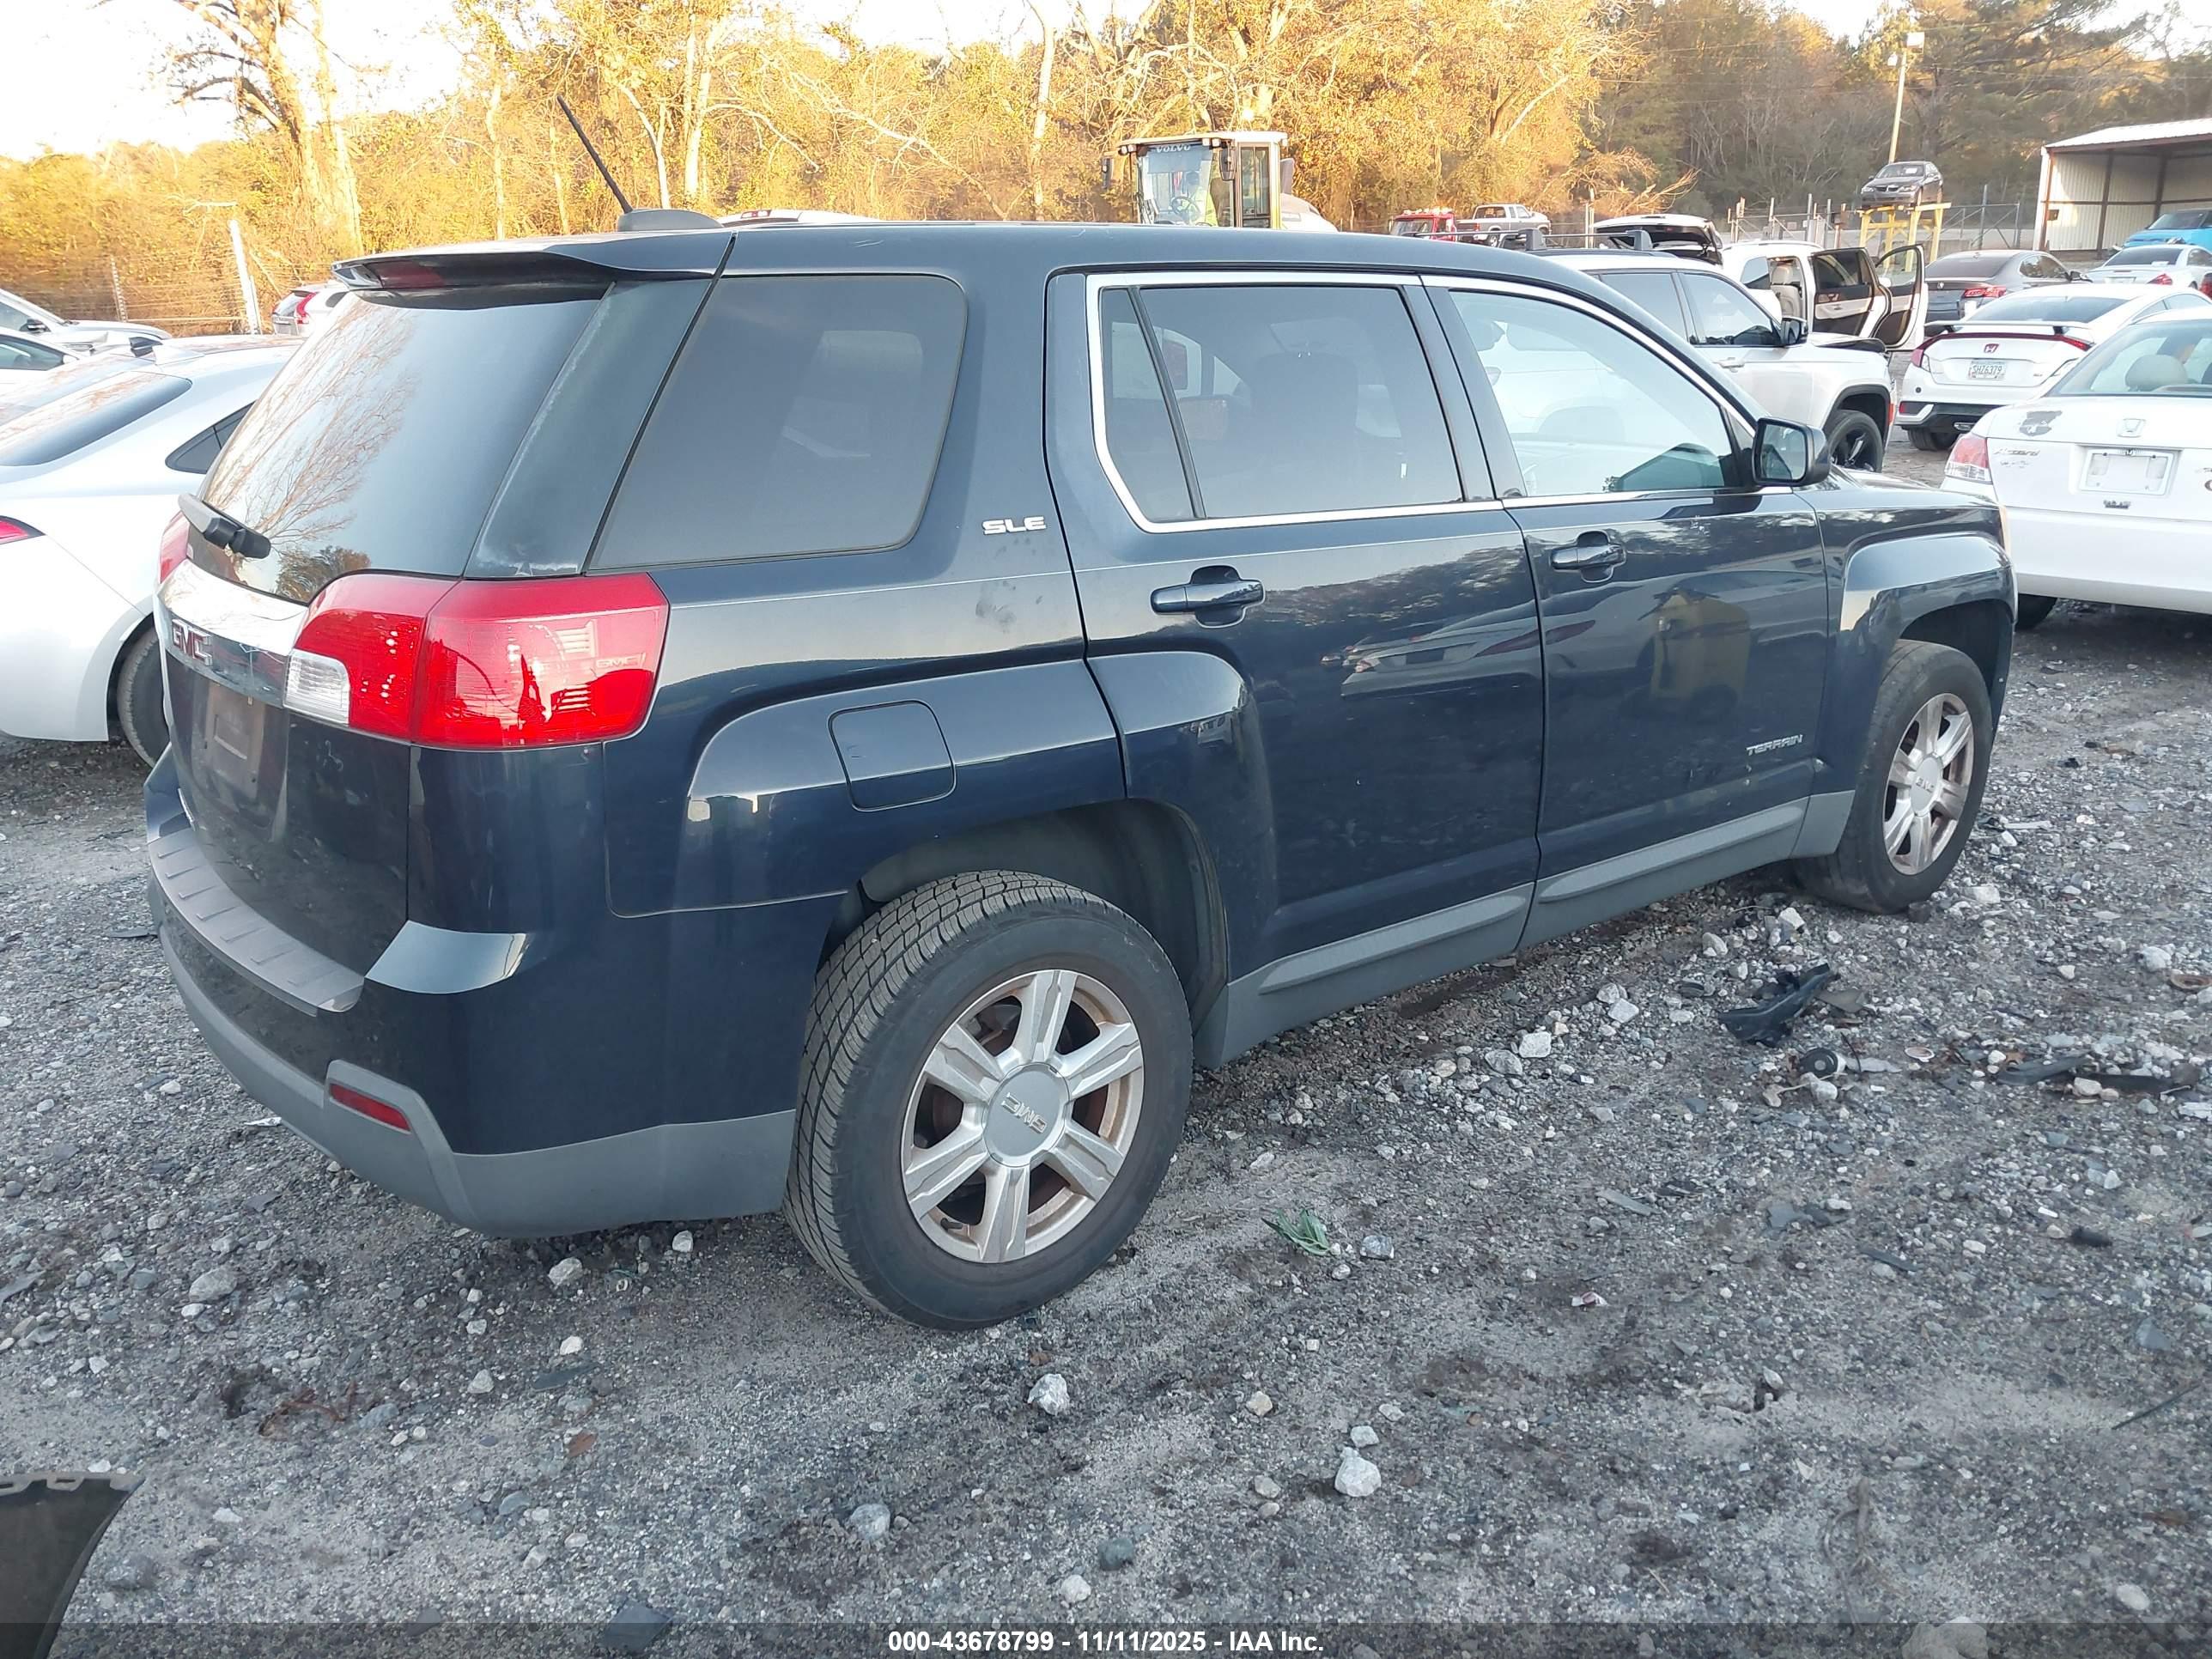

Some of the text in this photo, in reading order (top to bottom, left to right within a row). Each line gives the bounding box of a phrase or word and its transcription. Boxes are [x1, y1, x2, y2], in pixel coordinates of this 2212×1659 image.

[1156, 143, 1191, 154] VOLVO
[981, 515, 1047, 535] SLE
[172, 618, 213, 665] GMC
[1746, 734, 1803, 757] TERRAIN
[1000, 1091, 1048, 1133] GMC
